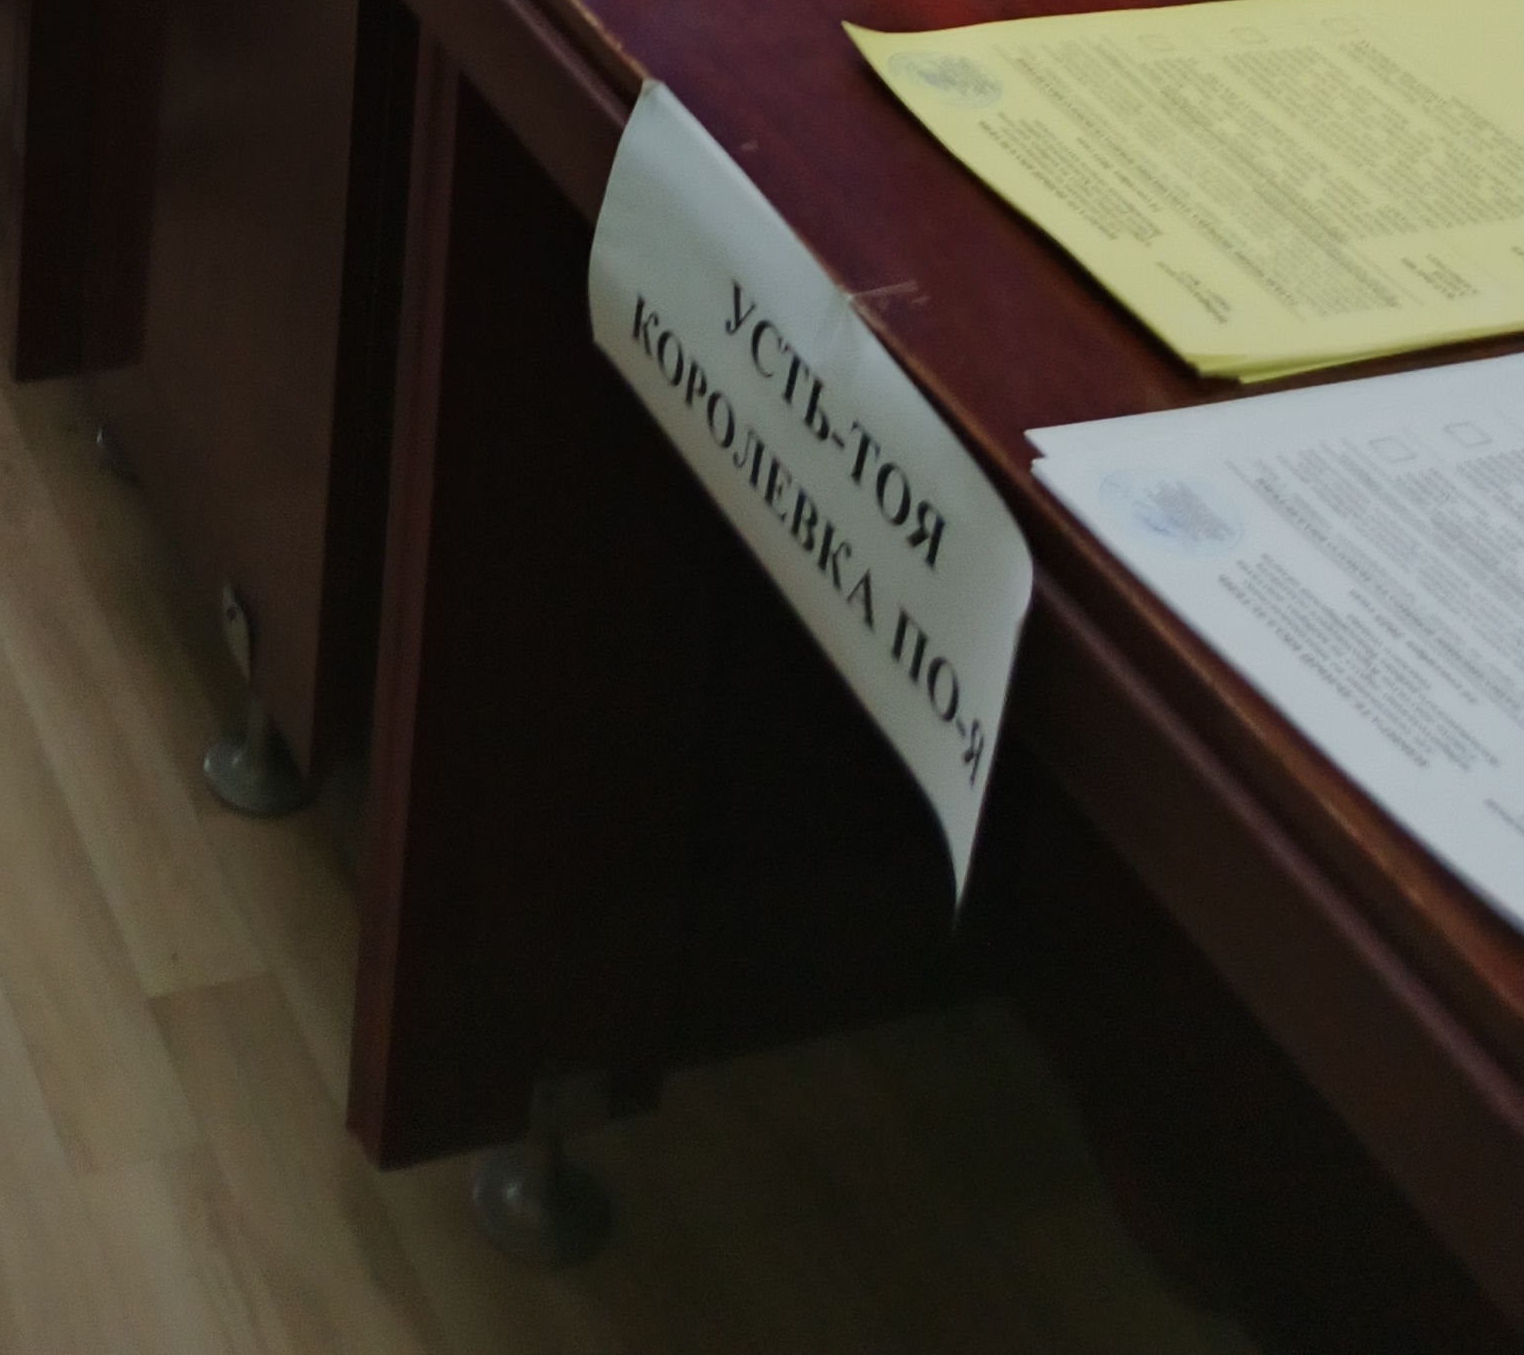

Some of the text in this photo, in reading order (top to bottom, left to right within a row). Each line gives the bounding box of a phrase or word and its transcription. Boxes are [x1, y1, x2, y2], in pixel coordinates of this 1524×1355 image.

[632, 293, 986, 787] КОРОЛЕВКА ПО-Я
[724, 278, 945, 572] УСТЬ-ТОЯ
